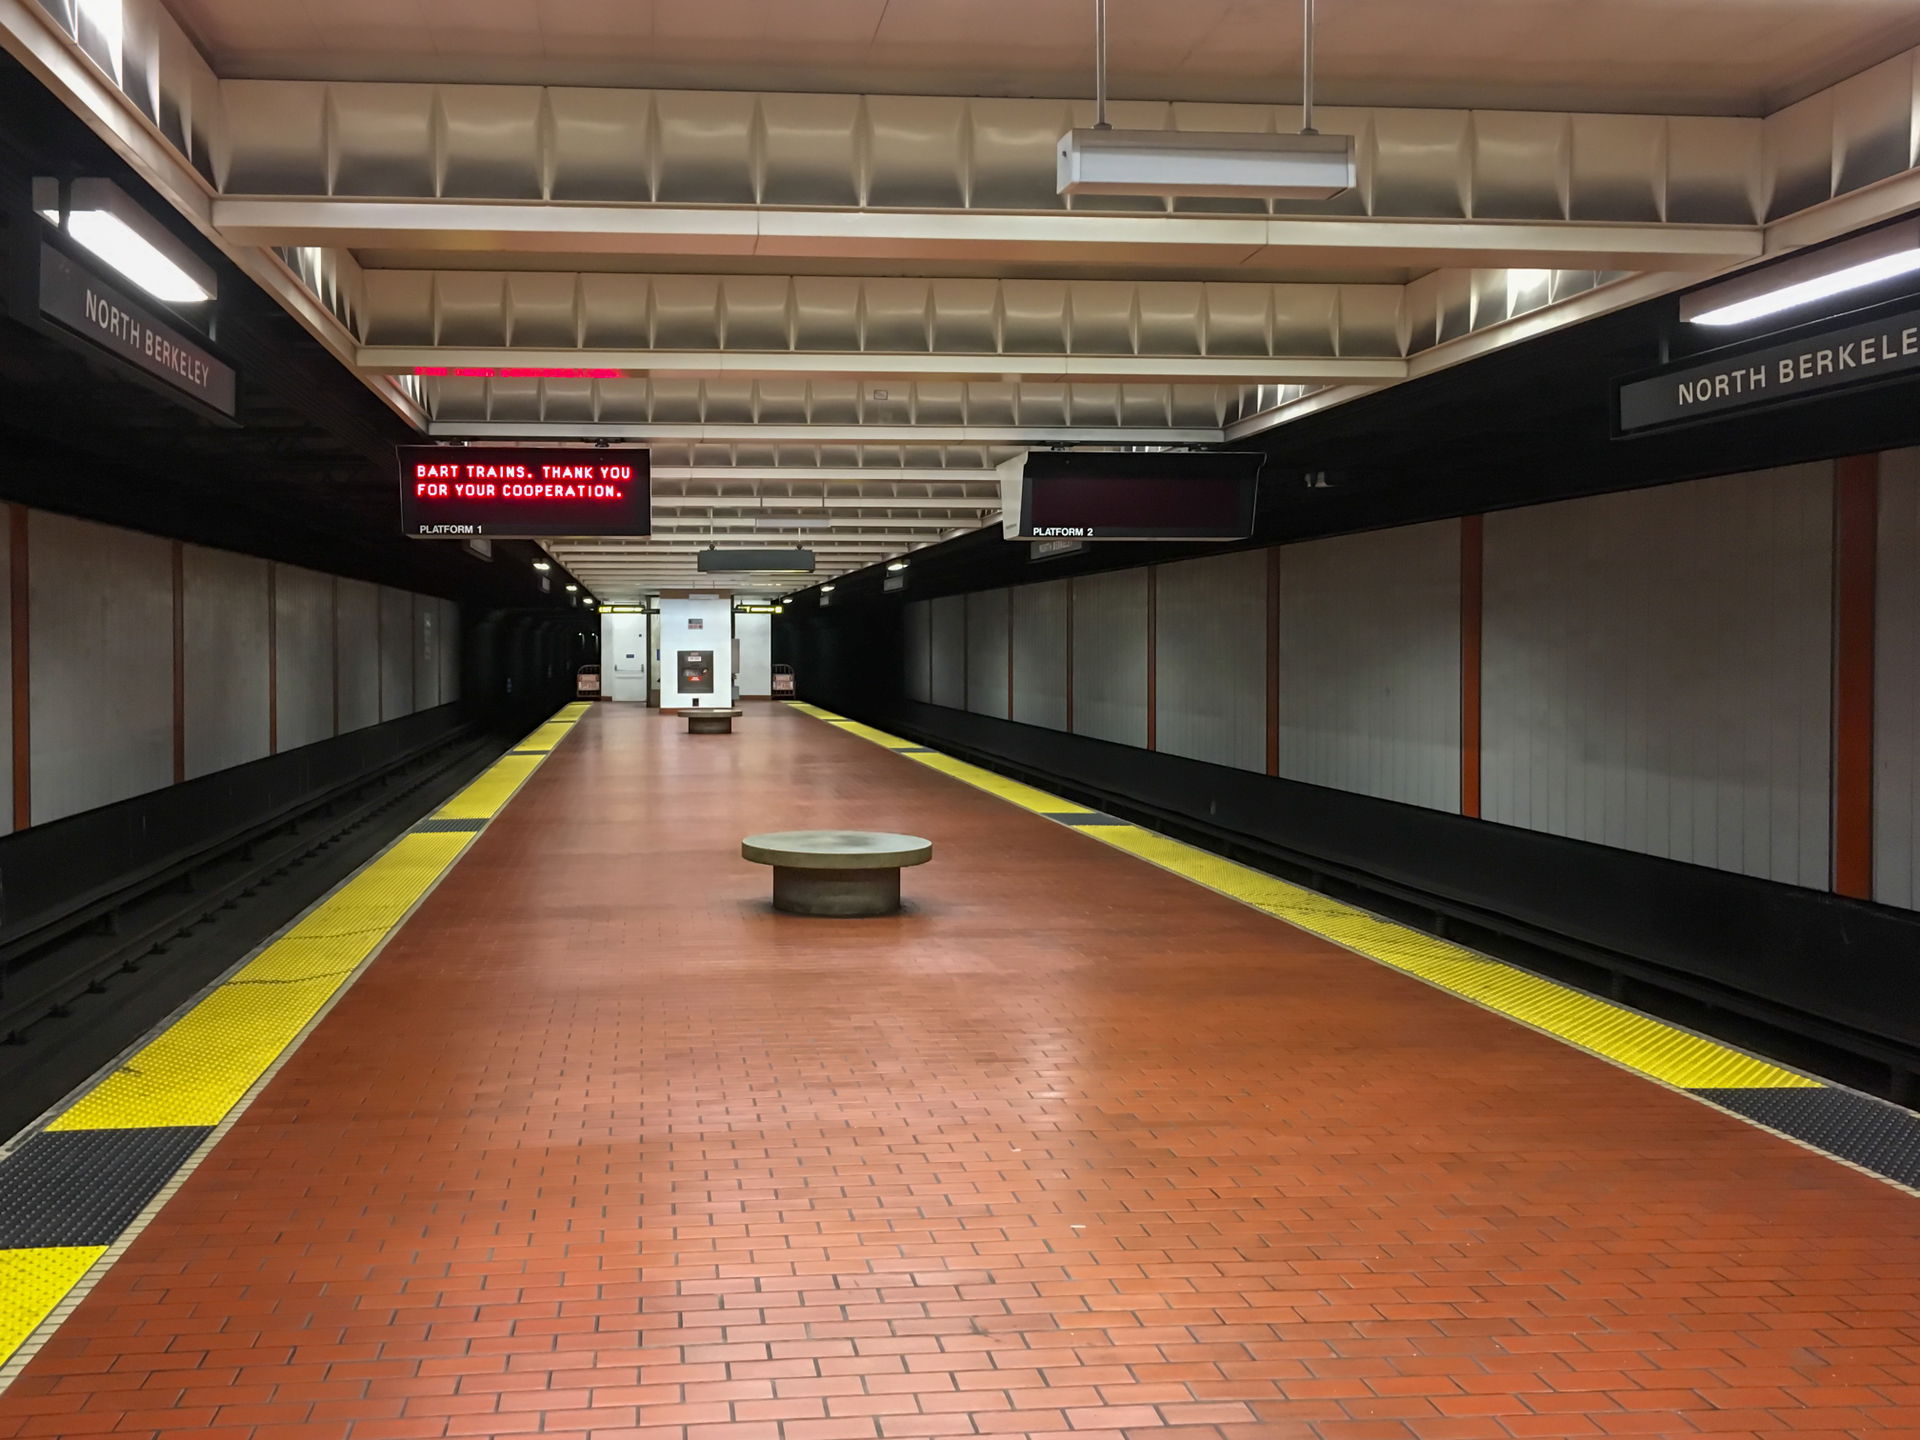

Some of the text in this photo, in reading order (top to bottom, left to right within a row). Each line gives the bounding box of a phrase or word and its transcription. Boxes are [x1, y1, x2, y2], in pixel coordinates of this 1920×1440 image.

[86, 290, 209, 387] NORTH BERKELEY
[1678, 365, 1766, 405] NORTH
[417, 465, 631, 479] BART TRAINS. THANK YOU
[417, 484, 622, 497] FOR YOUR COOPERATION.
[419, 525, 482, 534] PLATFORM 1
[1033, 527, 1093, 536] PLATFORM 2
